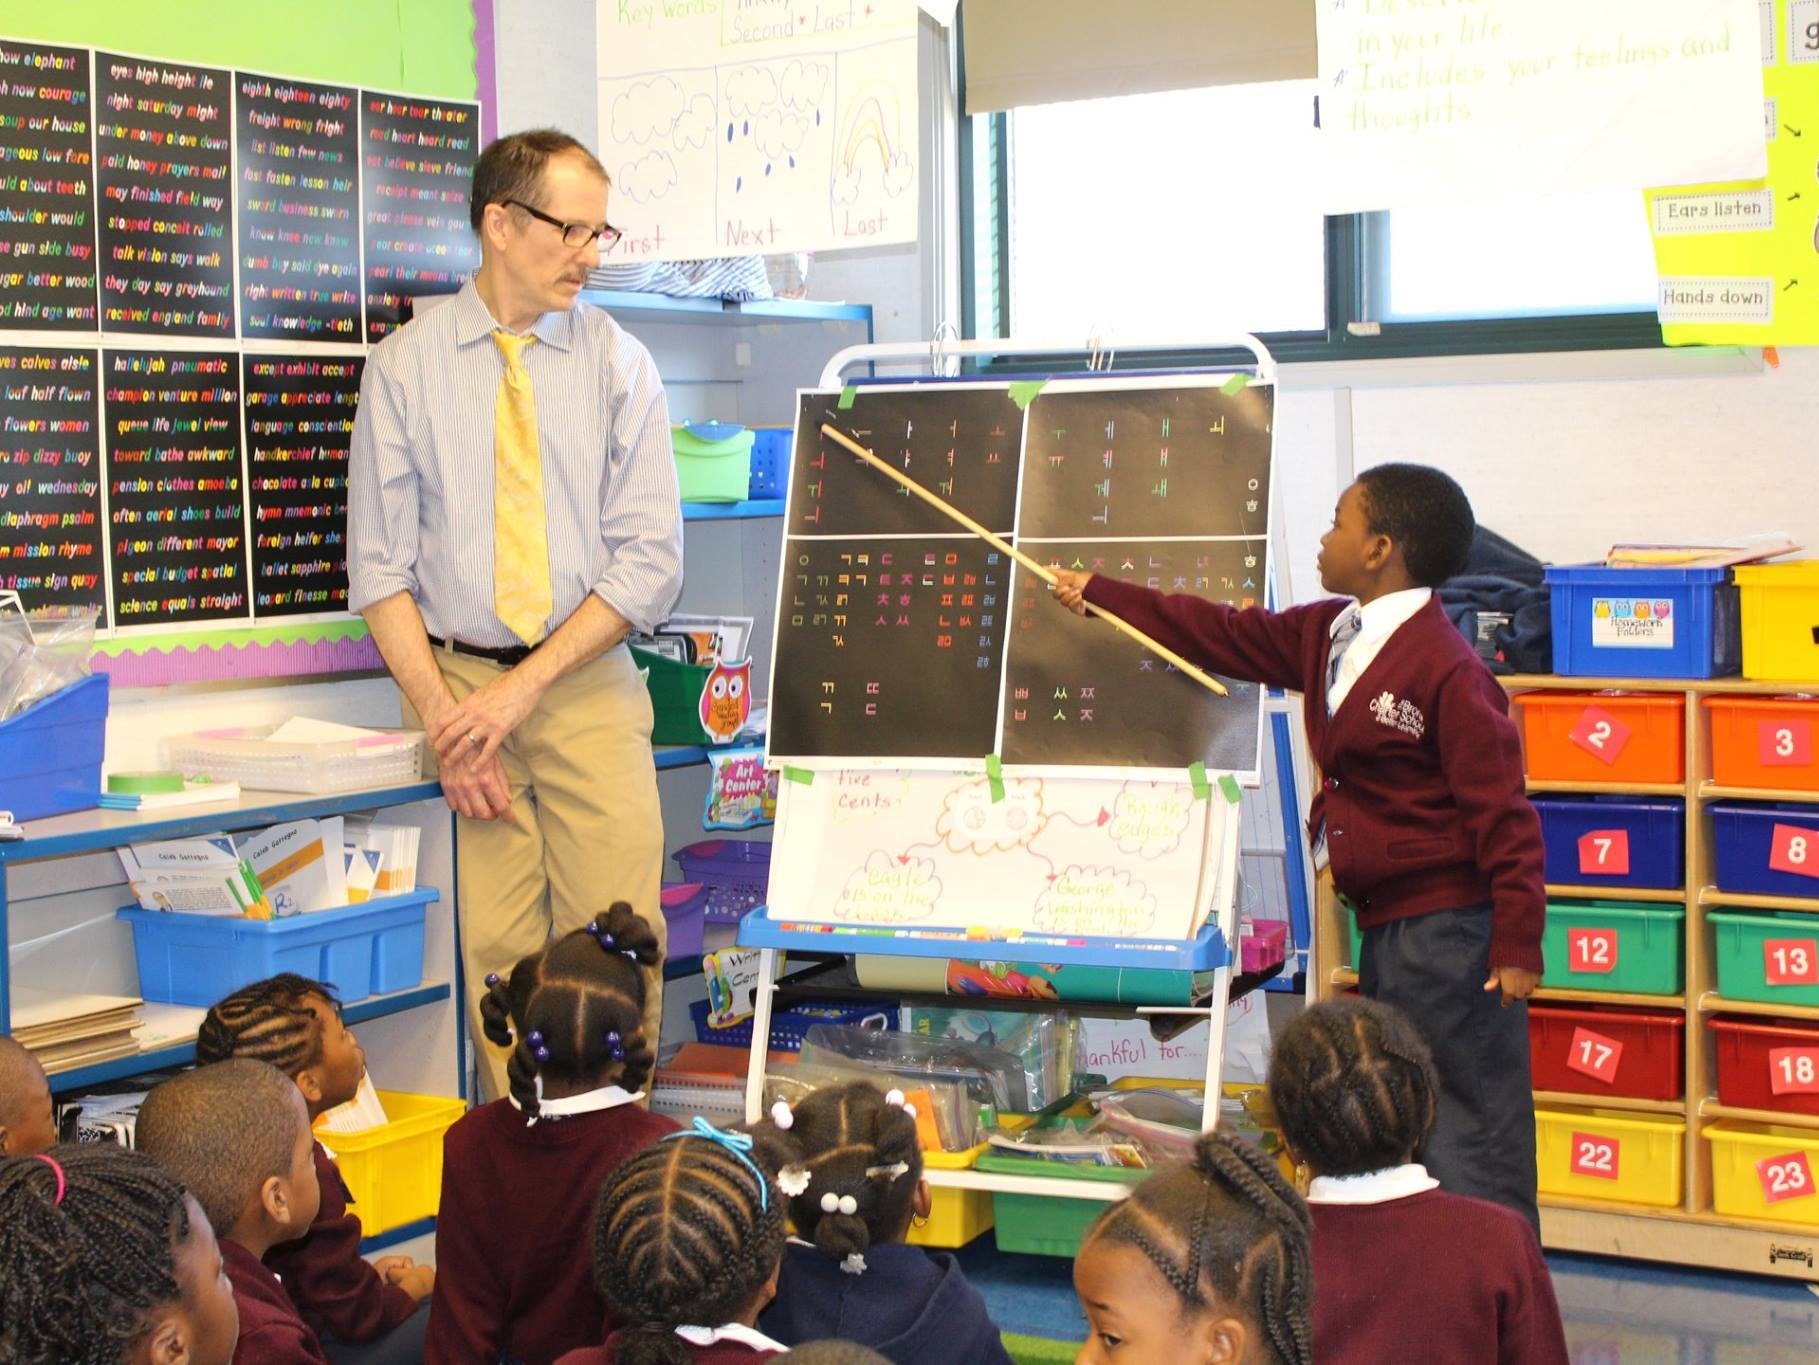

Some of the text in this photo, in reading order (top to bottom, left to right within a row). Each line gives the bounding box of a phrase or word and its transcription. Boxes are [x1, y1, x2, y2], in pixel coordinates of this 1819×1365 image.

[24, 51, 76, 71] elephant
[110, 64, 197, 90] eyes high height
[12, 84, 87, 105] now courage
[242, 80, 271, 98] eighth
[319, 91, 351, 110] eighty
[107, 92, 219, 122] night saturday might
[29, 115, 85, 133] our house
[249, 109, 345, 138] freight wrong fright
[98, 123, 228, 150] under money above down
[127, 154, 200, 178] honey prayers
[20, 177, 87, 195] about teeth
[106, 184, 223, 212] may finished field way
[51, 210, 85, 227] would
[1669, 199, 1762, 219] Ears listen
[108, 216, 223, 237] stopped conceit rolled
[726, 217, 780, 247] Next
[844, 208, 889, 237] Last
[14, 240, 91, 260] gun side busy
[112, 245, 221, 268] talk vision says walk
[27, 271, 95, 288] better wood
[105, 274, 230, 298] they day say greyhound
[1664, 287, 1763, 305] Hands down
[42, 305, 95, 321] age want
[106, 307, 195, 327] received england
[20, 354, 57, 370] calves
[114, 356, 228, 376] hallelujah pneumatic
[253, 362, 355, 378] except accept
[31, 385, 91, 402] half flown
[107, 387, 198, 405] champion venture
[4, 416, 90, 433] flowers women
[204, 417, 229, 432] view
[13, 448, 92, 467] zip dizzy buoy
[114, 445, 235, 463] toward bathe awkward
[38, 480, 98, 497] wednesday
[112, 476, 238, 497] pension clothes amoeba
[252, 475, 298, 491] chocolate
[62, 510, 95, 529] psalm
[113, 505, 210, 524] often aerial shoes
[257, 504, 282, 522] hymn
[13, 541, 93, 559] mission rhyme
[117, 536, 239, 558] pigeon different mayor
[122, 566, 199, 587] special budget
[291, 560, 331, 576] sapphire
[44, 572, 98, 591] sign quay
[120, 597, 158, 615] science
[161, 594, 196, 615] equals
[200, 591, 243, 610] straight
[1587, 721, 1794, 756] 2 3
[736, 764, 754, 777] Art
[725, 775, 762, 793] Center
[1594, 836, 1807, 864] 7 8
[1576, 937, 1808, 975] 12 13
[1579, 1040, 1814, 1083] 17 18
[1578, 1142, 1806, 1192] 22 23
